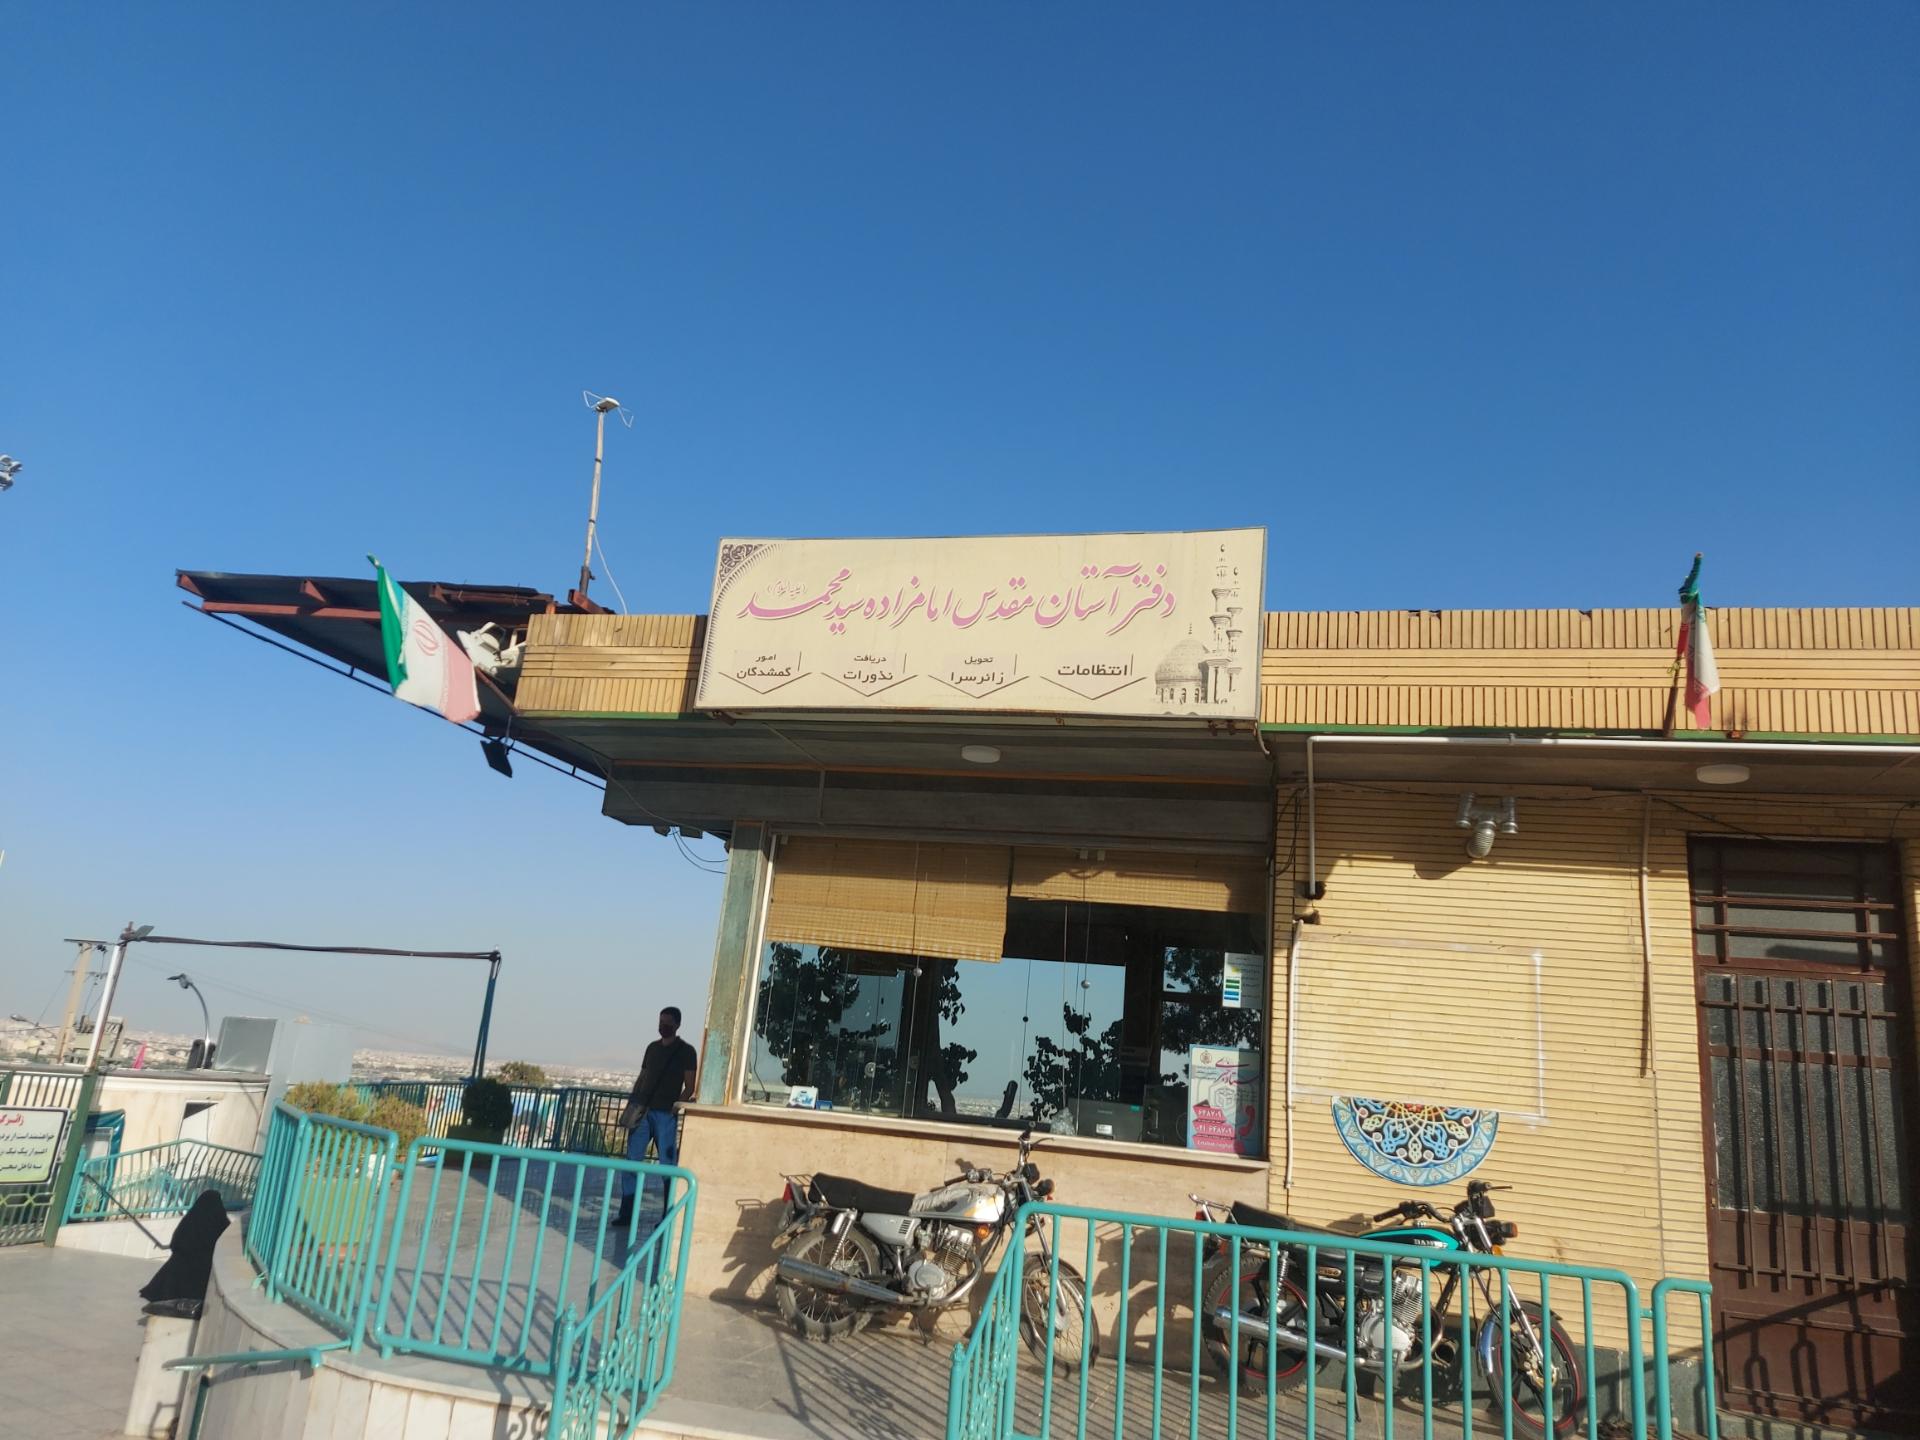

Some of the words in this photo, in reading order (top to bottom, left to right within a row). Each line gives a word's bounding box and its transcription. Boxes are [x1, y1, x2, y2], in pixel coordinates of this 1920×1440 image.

[737, 568, 850, 620] محمد
[863, 576, 953, 630] امامزاده
[951, 576, 1034, 629] مقدس
[1034, 562, 1142, 628] آستان
[1106, 563, 1177, 636] دفتر
[823, 597, 865, 635] سید
[755, 653, 777, 662] امور
[843, 670, 894, 683] نذورات
[853, 654, 887, 664] دریافت
[964, 655, 994, 665] تحویل
[1057, 664, 1128, 677] انتظامات
